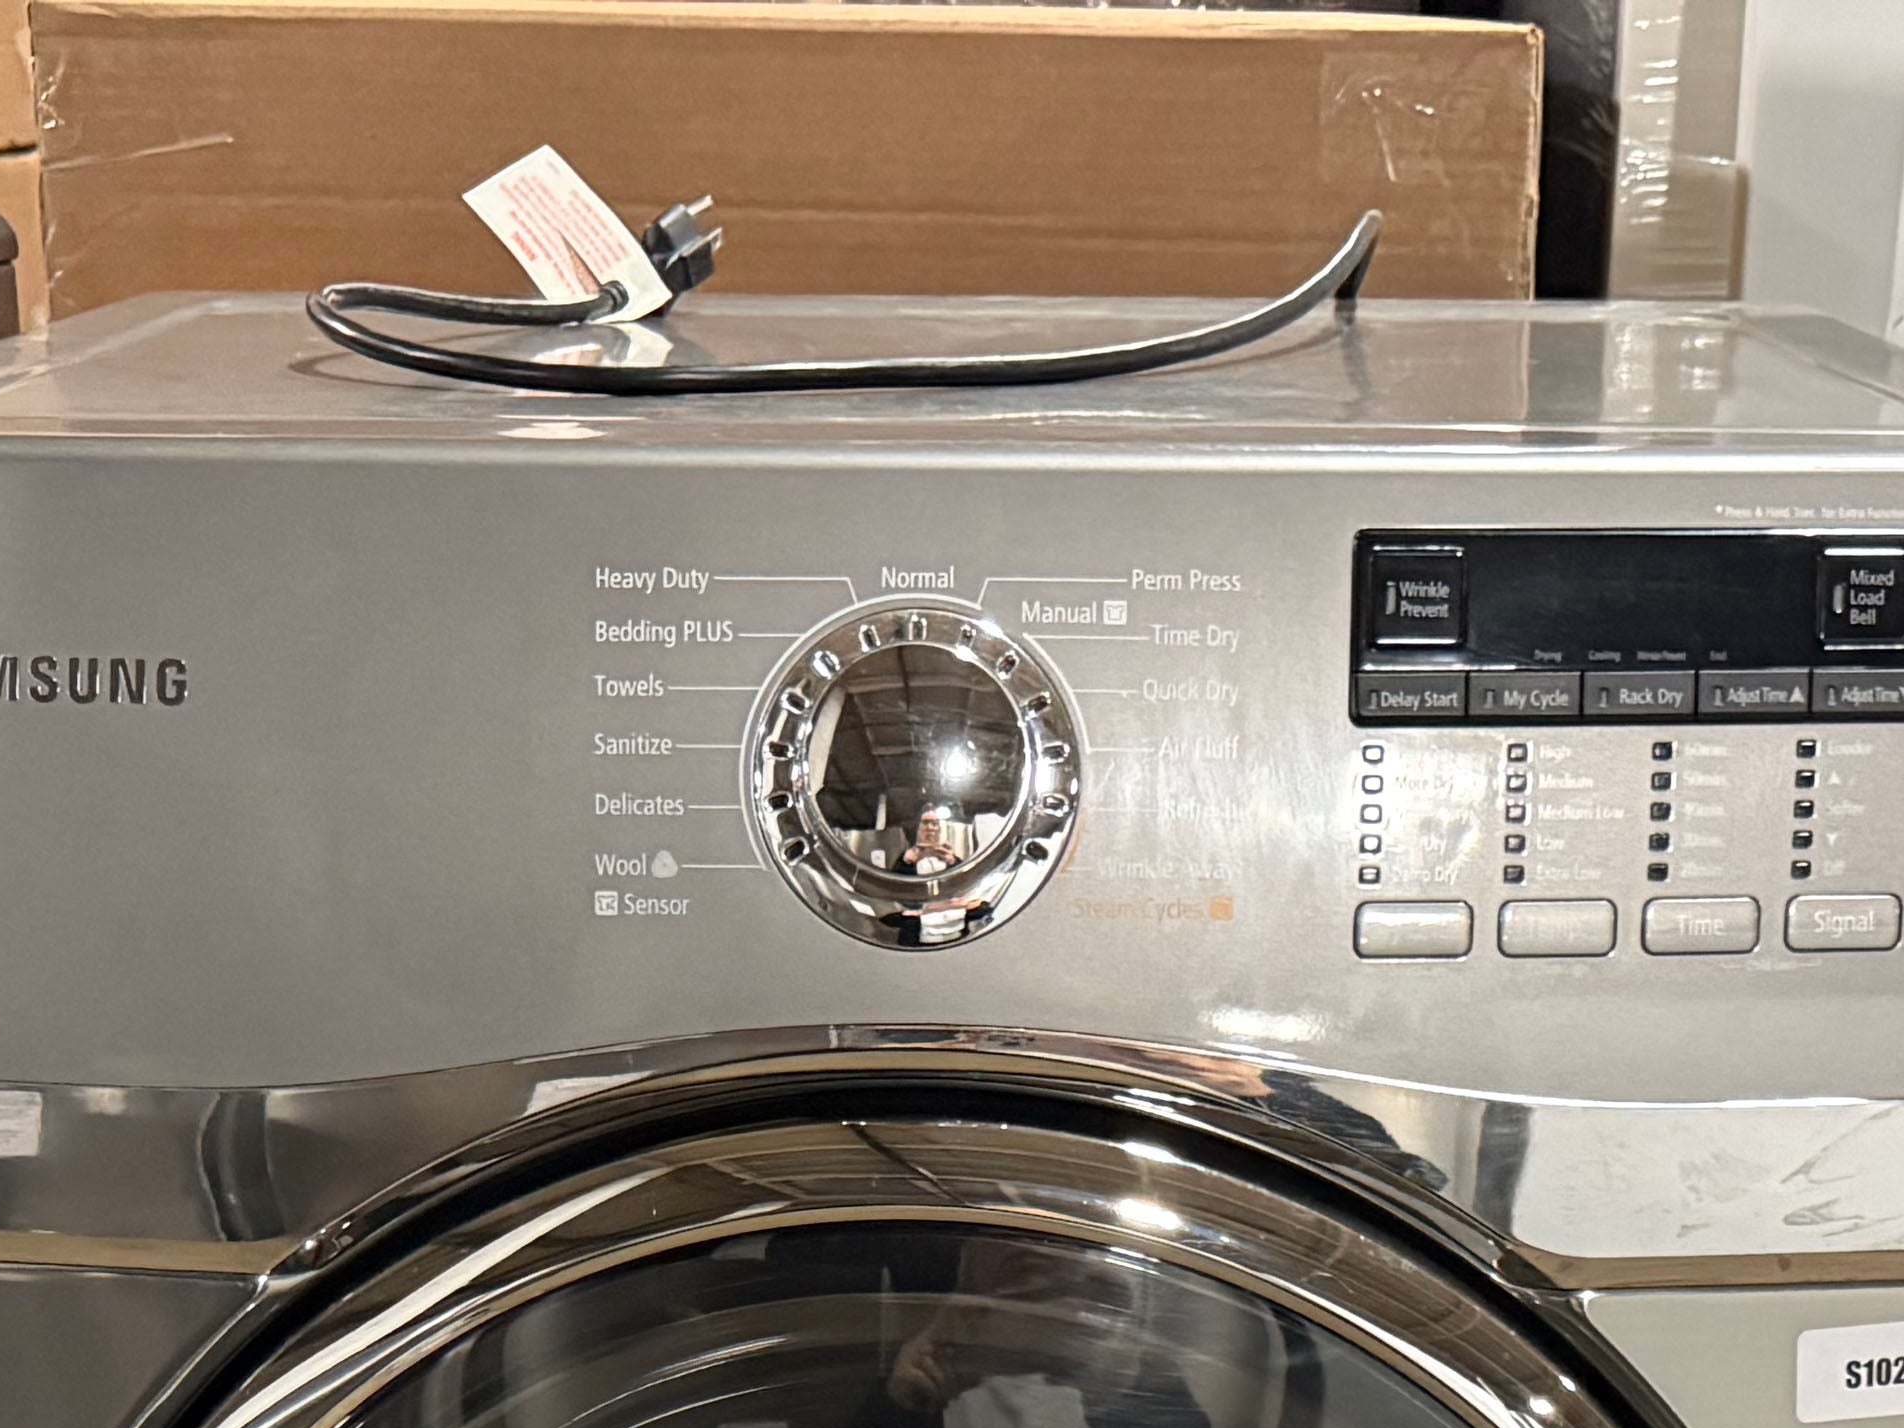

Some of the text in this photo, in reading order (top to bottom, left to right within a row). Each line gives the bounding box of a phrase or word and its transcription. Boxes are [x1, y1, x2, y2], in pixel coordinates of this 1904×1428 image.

[596, 566, 710, 595] Heavy Duty
[881, 565, 955, 589] Normal
[1132, 569, 1241, 592] Perm Press
[1850, 569, 1894, 587] Mixed
[1399, 581, 1450, 598] Wrinkle
[1850, 589, 1885, 606] Load
[1021, 600, 1097, 625] Manual
[1400, 600, 1449, 618] Prevent
[1850, 609, 1877, 625] Bell
[596, 619, 734, 648] Bedding PLUS
[1151, 624, 1240, 652] Time Dry
[593, 672, 664, 697] Towels
[1143, 679, 1238, 707] Quick Dry
[1381, 690, 1458, 711] Delay Start
[1504, 689, 1568, 710] My Cycle
[1619, 687, 1683, 708] Rack Dry
[1728, 687, 1788, 707] Adjust Time
[1841, 687, 1900, 707] Adjust Time
[594, 733, 672, 755] Sanitize
[1540, 745, 1571, 763] High
[1539, 773, 1594, 789] Medium
[595, 792, 685, 815] Delicates
[1537, 804, 1593, 820] Medium
[1537, 835, 1566, 851] Low
[595, 853, 647, 876] Wool
[624, 893, 690, 916] Sensor
[1677, 916, 1724, 936] Time
[1813, 909, 1875, 938] Signal
